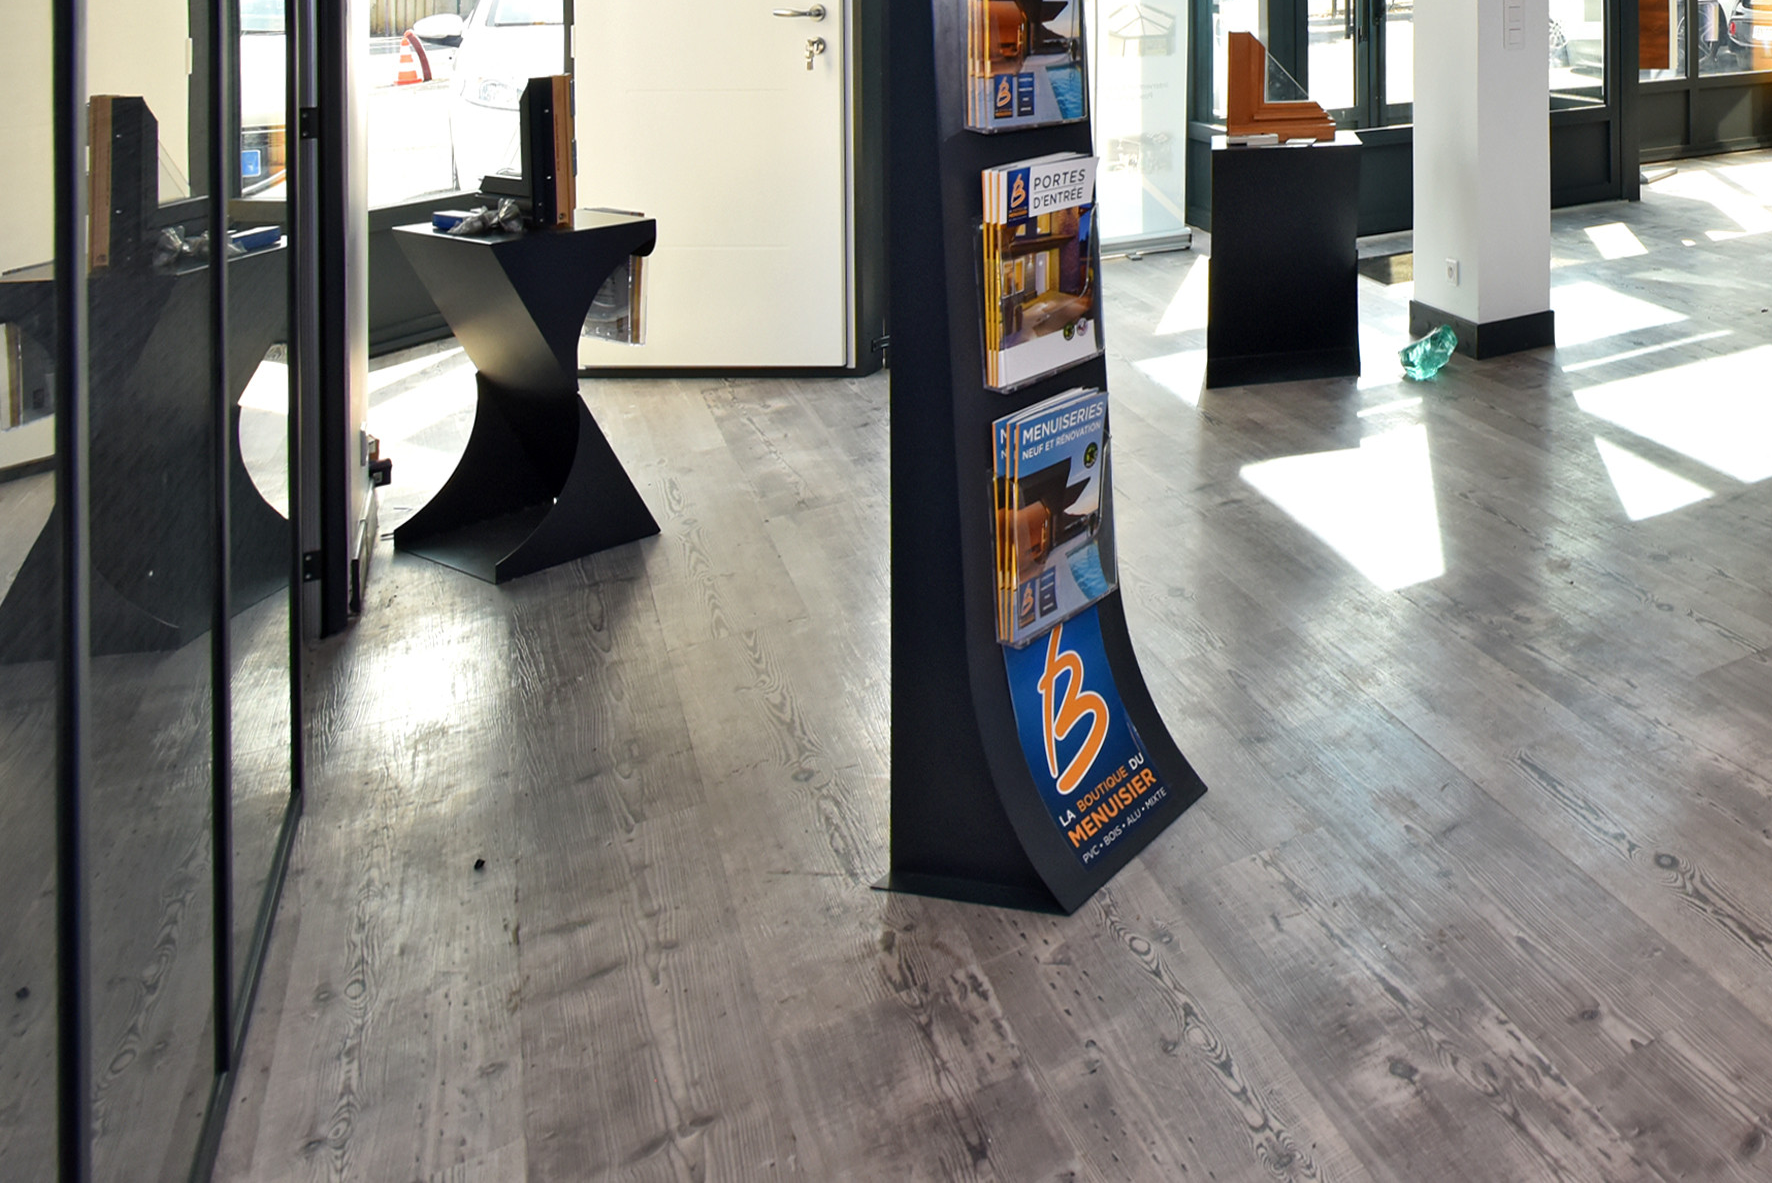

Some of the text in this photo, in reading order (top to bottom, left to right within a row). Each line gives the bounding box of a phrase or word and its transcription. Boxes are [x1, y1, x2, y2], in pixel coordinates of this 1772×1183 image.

[1033, 186, 1083, 209] D'ENTRÉE
[1034, 169, 1086, 190] PORTES
[1022, 442, 1044, 460] NEUF
[1044, 439, 1054, 451] ET
[1055, 420, 1101, 447] RÉNOVATION
[1023, 402, 1103, 445] MENUISERIES
[1059, 752, 1145, 827] LA BOUTIQUE DU
[1067, 767, 1157, 848] MENUISIER
[1082, 786, 1167, 864] PVC BOIS ALU MIXTE
